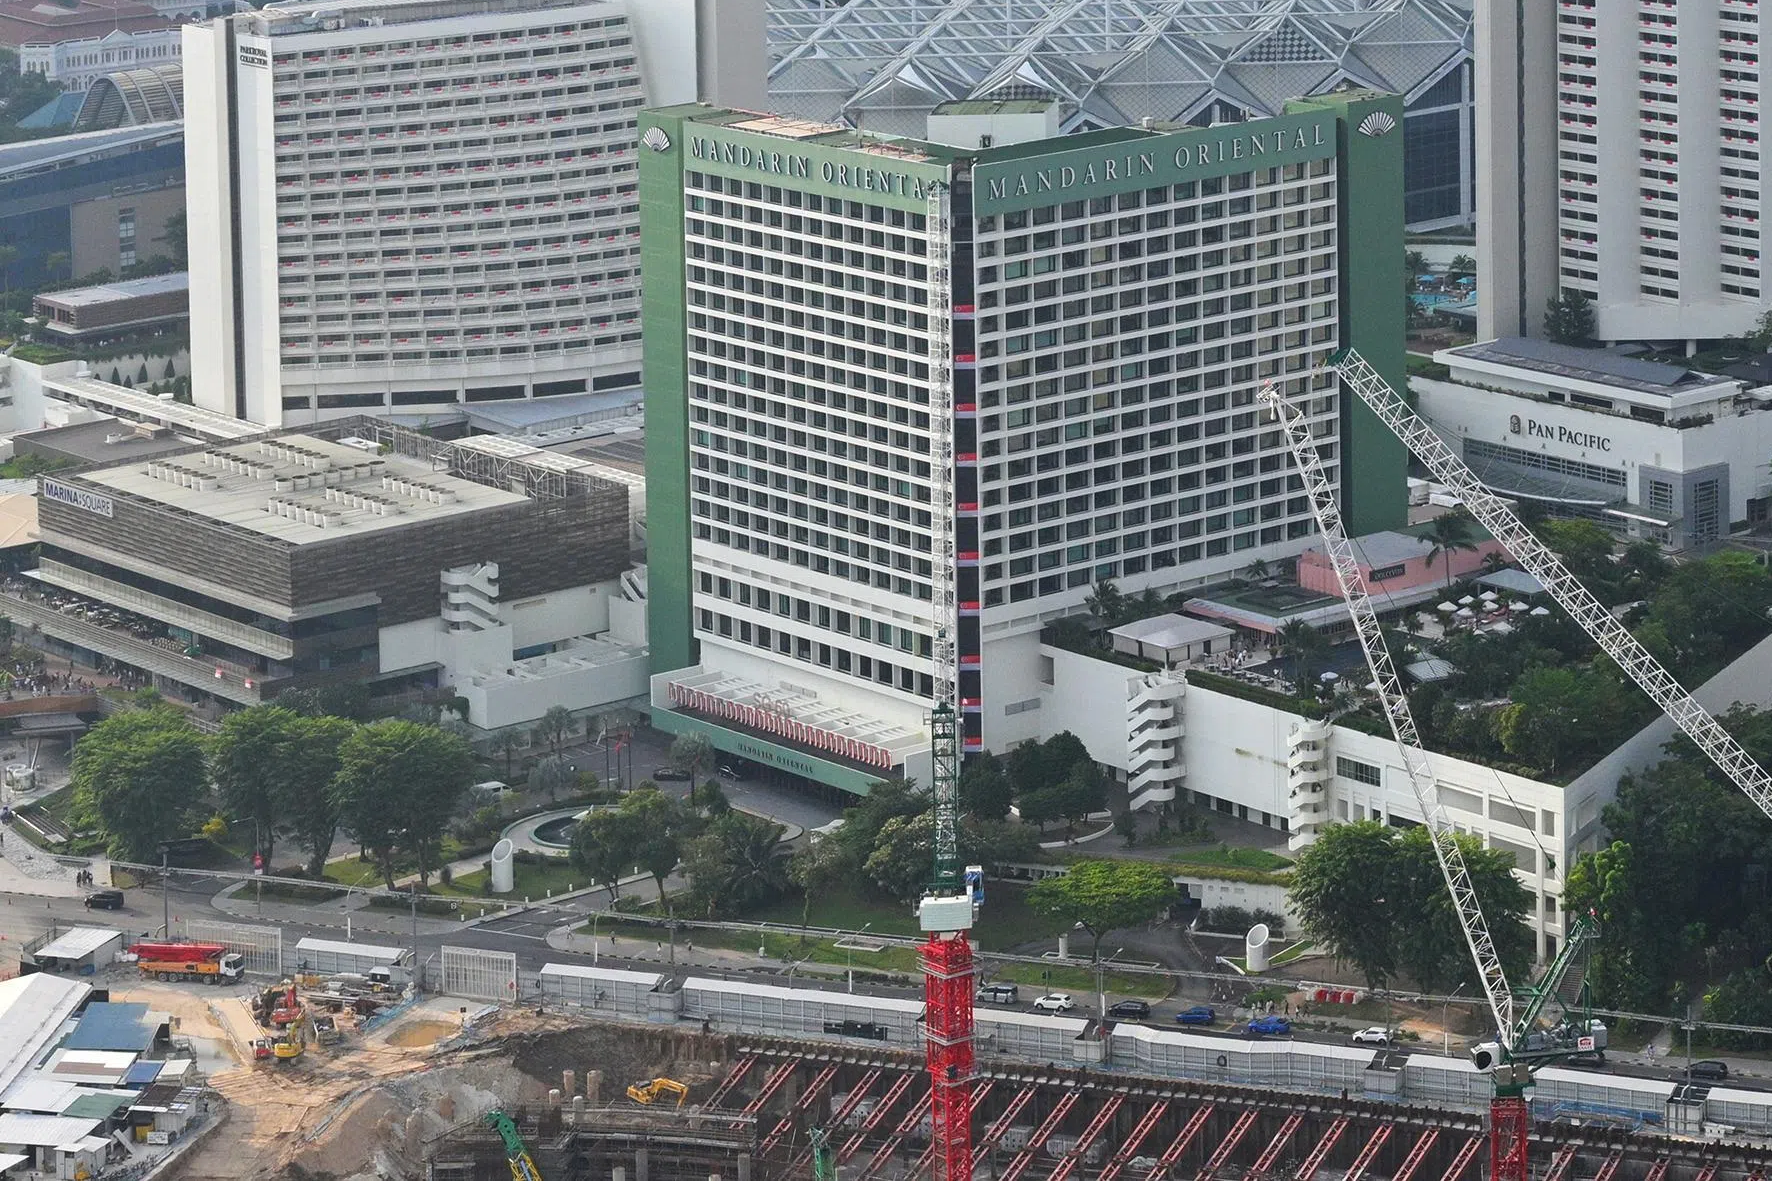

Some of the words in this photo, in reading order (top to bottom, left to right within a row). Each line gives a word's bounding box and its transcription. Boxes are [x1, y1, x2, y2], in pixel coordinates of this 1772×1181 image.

[691, 136, 810, 178] MANDARIN
[821, 161, 926, 200] ORIENTA
[988, 152, 1156, 201] MANDARIN
[1175, 124, 1326, 169] ORIENTAL
[45, 482, 79, 505] MARINA
[82, 494, 110, 515] SQUARE
